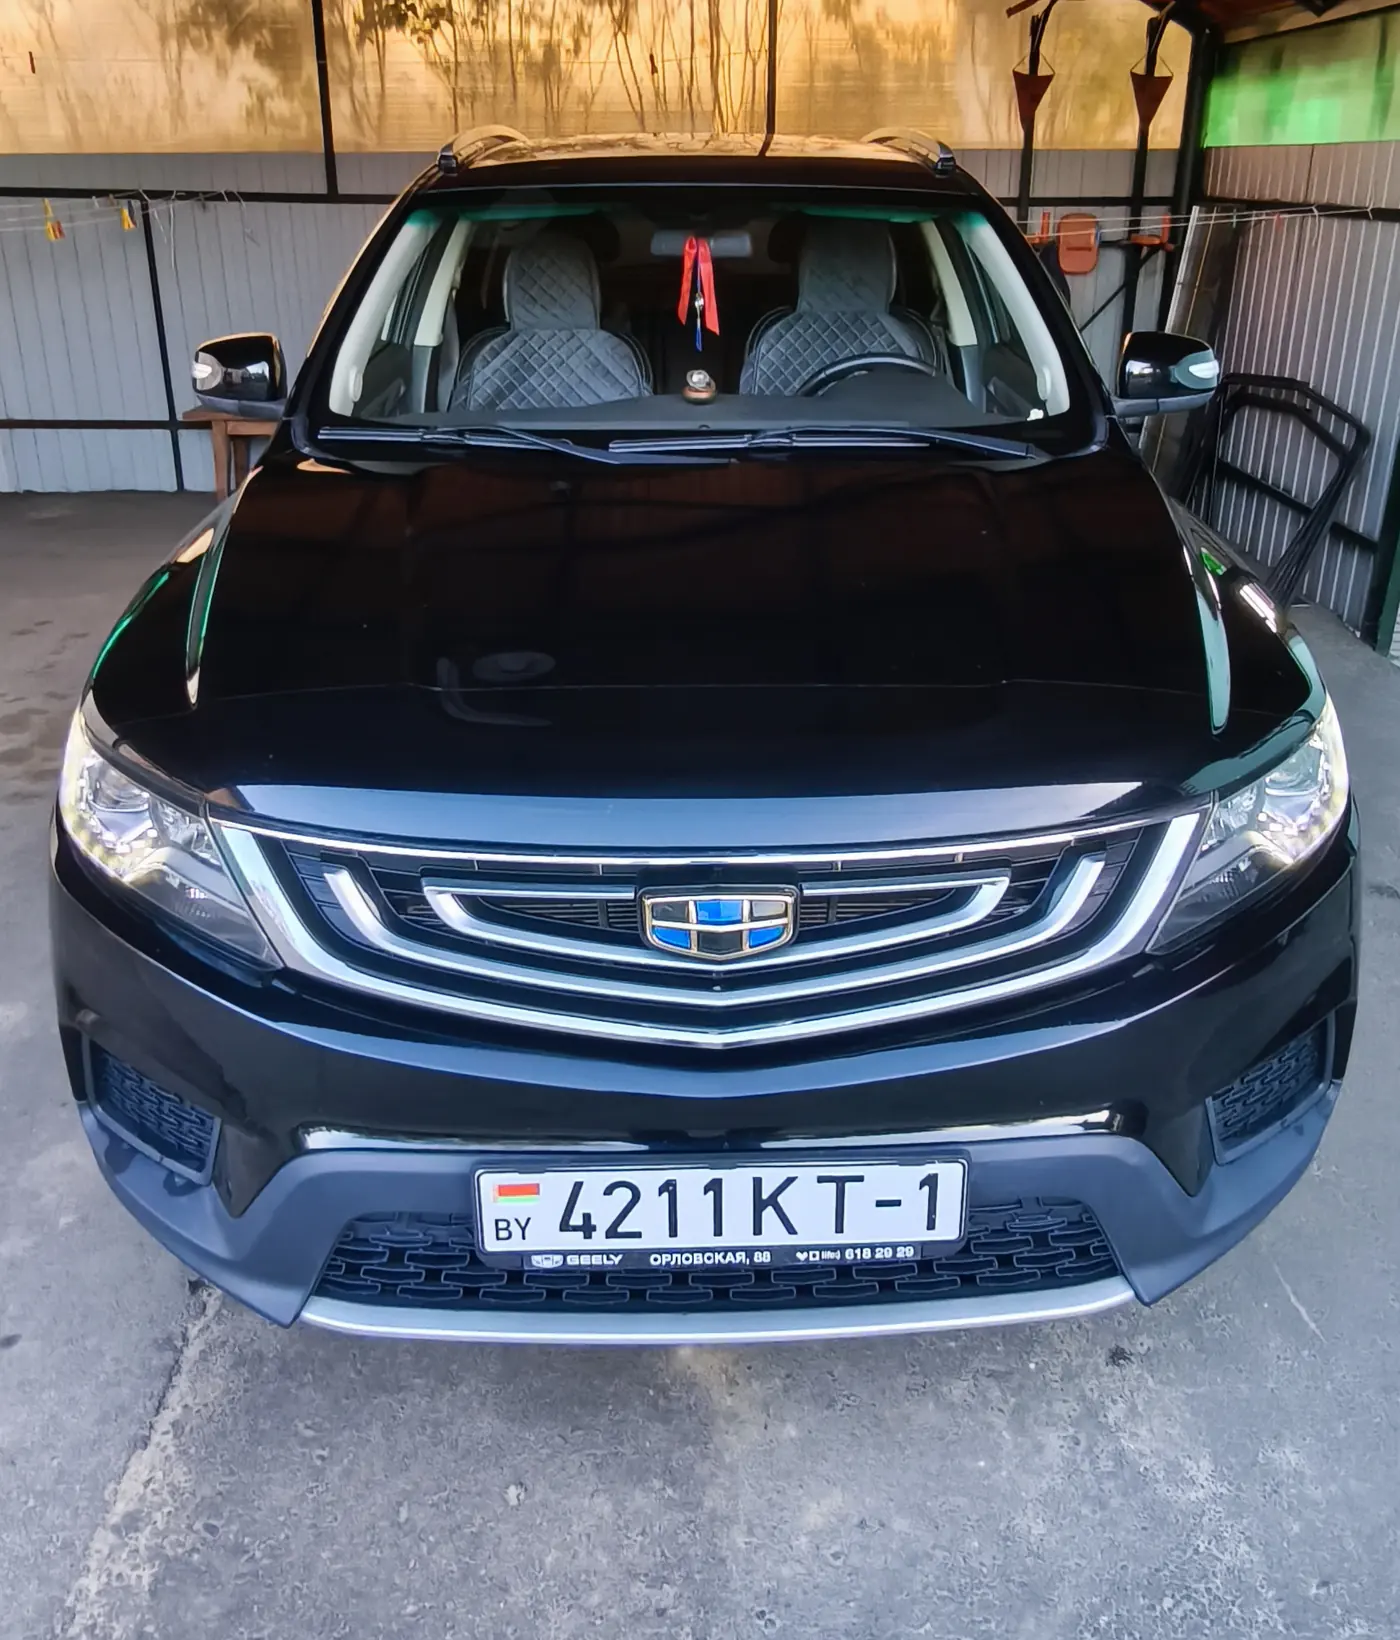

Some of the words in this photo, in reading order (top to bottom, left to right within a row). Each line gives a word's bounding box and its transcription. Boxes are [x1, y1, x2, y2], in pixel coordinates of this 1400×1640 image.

[493, 1217, 532, 1241] BY
[566, 1253, 624, 1266] GEELY
[649, 1251, 750, 1267] ОРЛОВСКАЯ,
